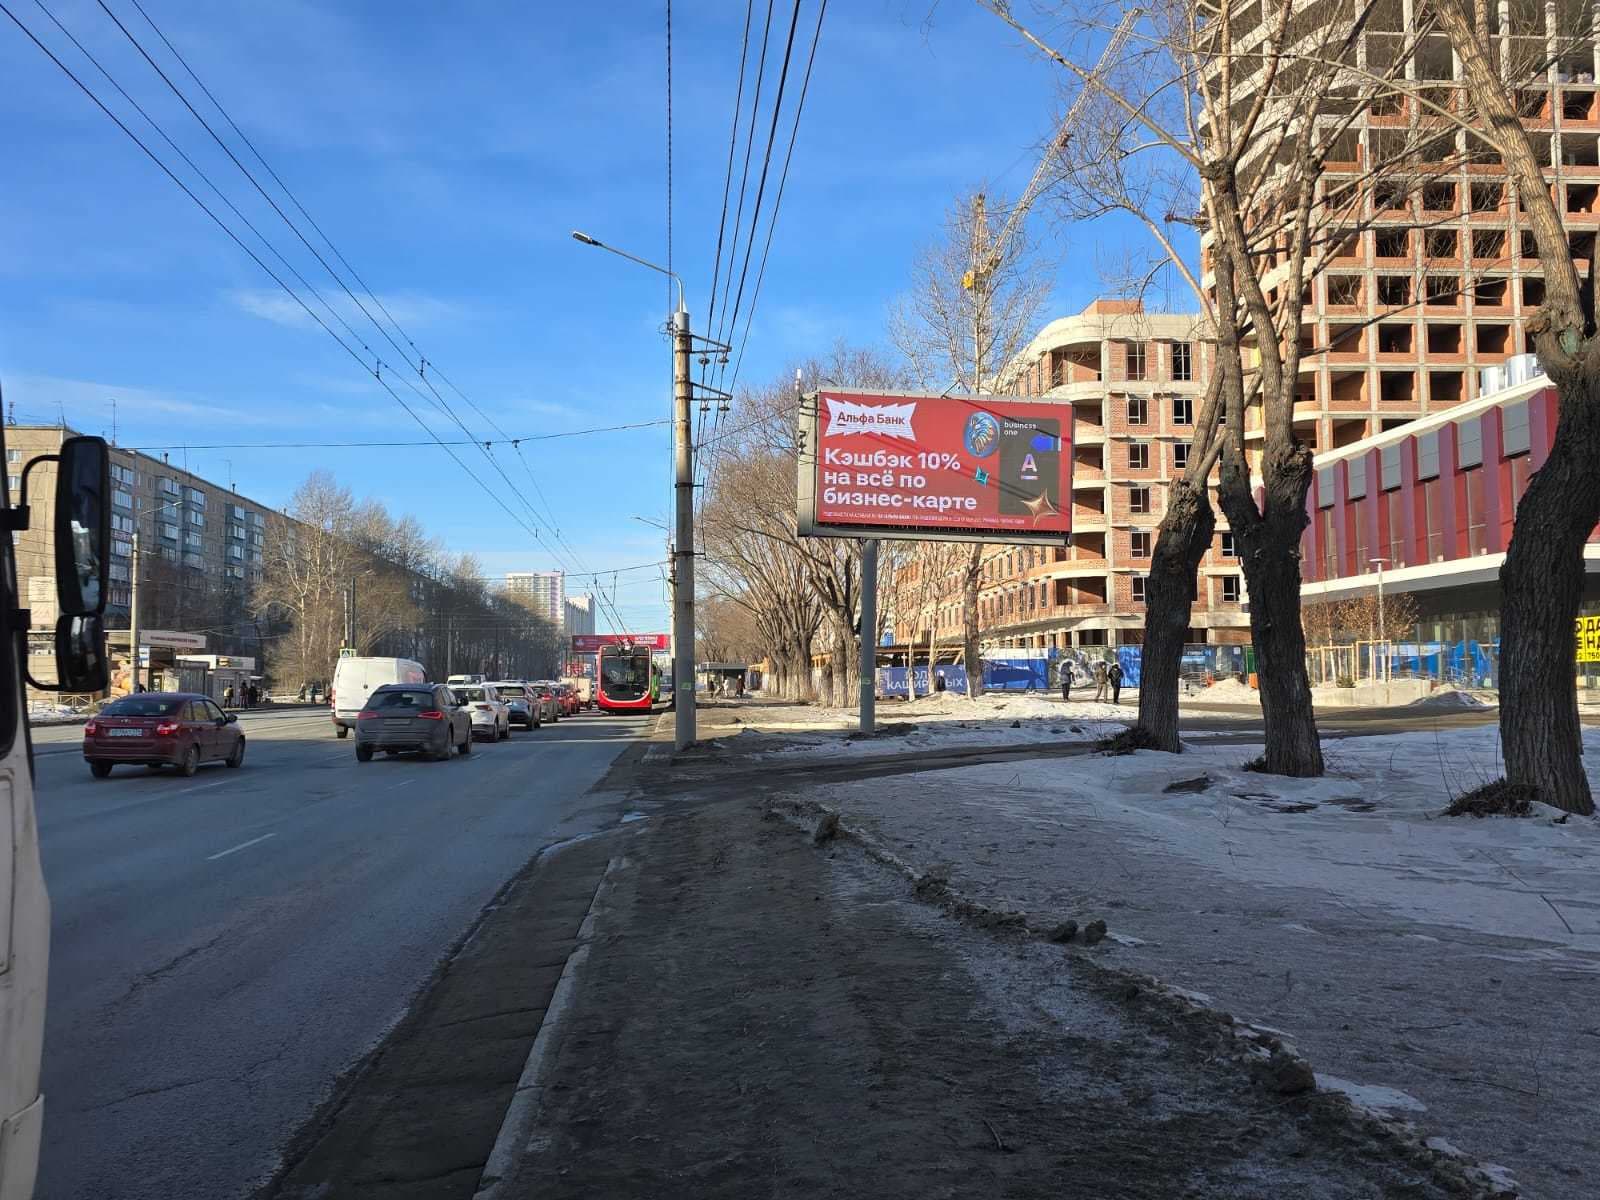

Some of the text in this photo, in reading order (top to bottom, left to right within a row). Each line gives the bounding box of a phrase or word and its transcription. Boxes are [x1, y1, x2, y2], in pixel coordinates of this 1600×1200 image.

[837, 411, 905, 426] Альфа Банк
[1004, 419, 1037, 430] business
[824, 447, 961, 470] Кэшбэк 10%
[824, 470, 926, 488] на всё по
[823, 487, 978, 512] бизнес-карте
